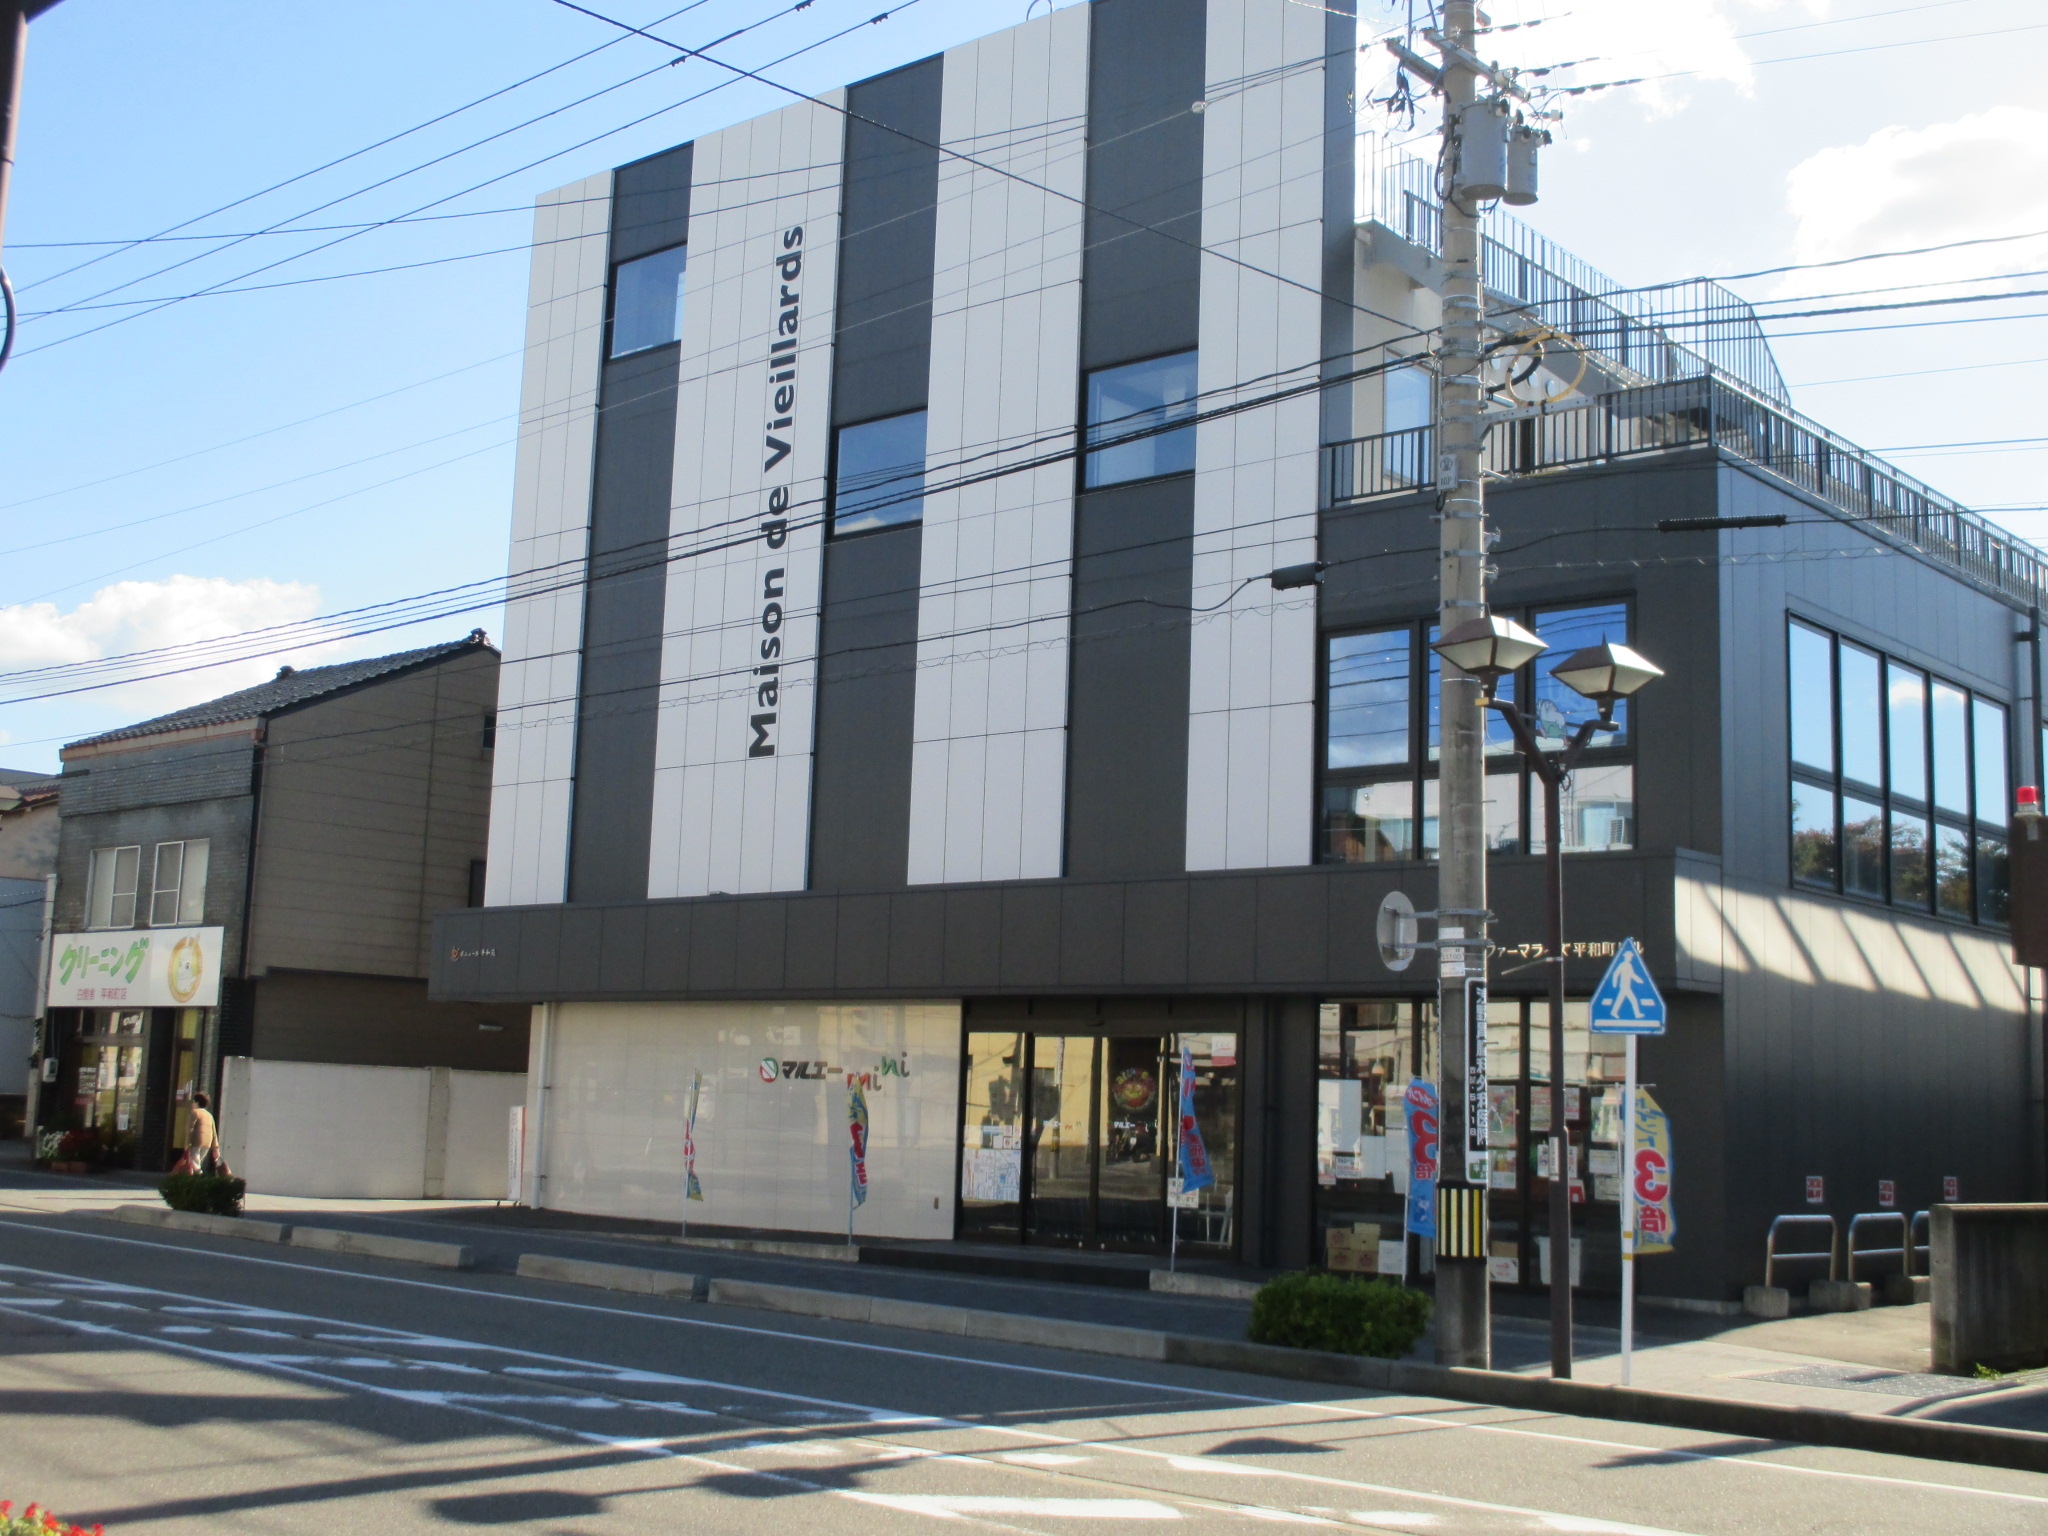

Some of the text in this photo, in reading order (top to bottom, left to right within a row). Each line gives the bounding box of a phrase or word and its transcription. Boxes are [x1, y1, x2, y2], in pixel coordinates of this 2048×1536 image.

[748, 226, 804, 758] Maison de Vieillards
[59, 937, 149, 985] クリーニング
[782, 1061, 843, 1080] マルエー
